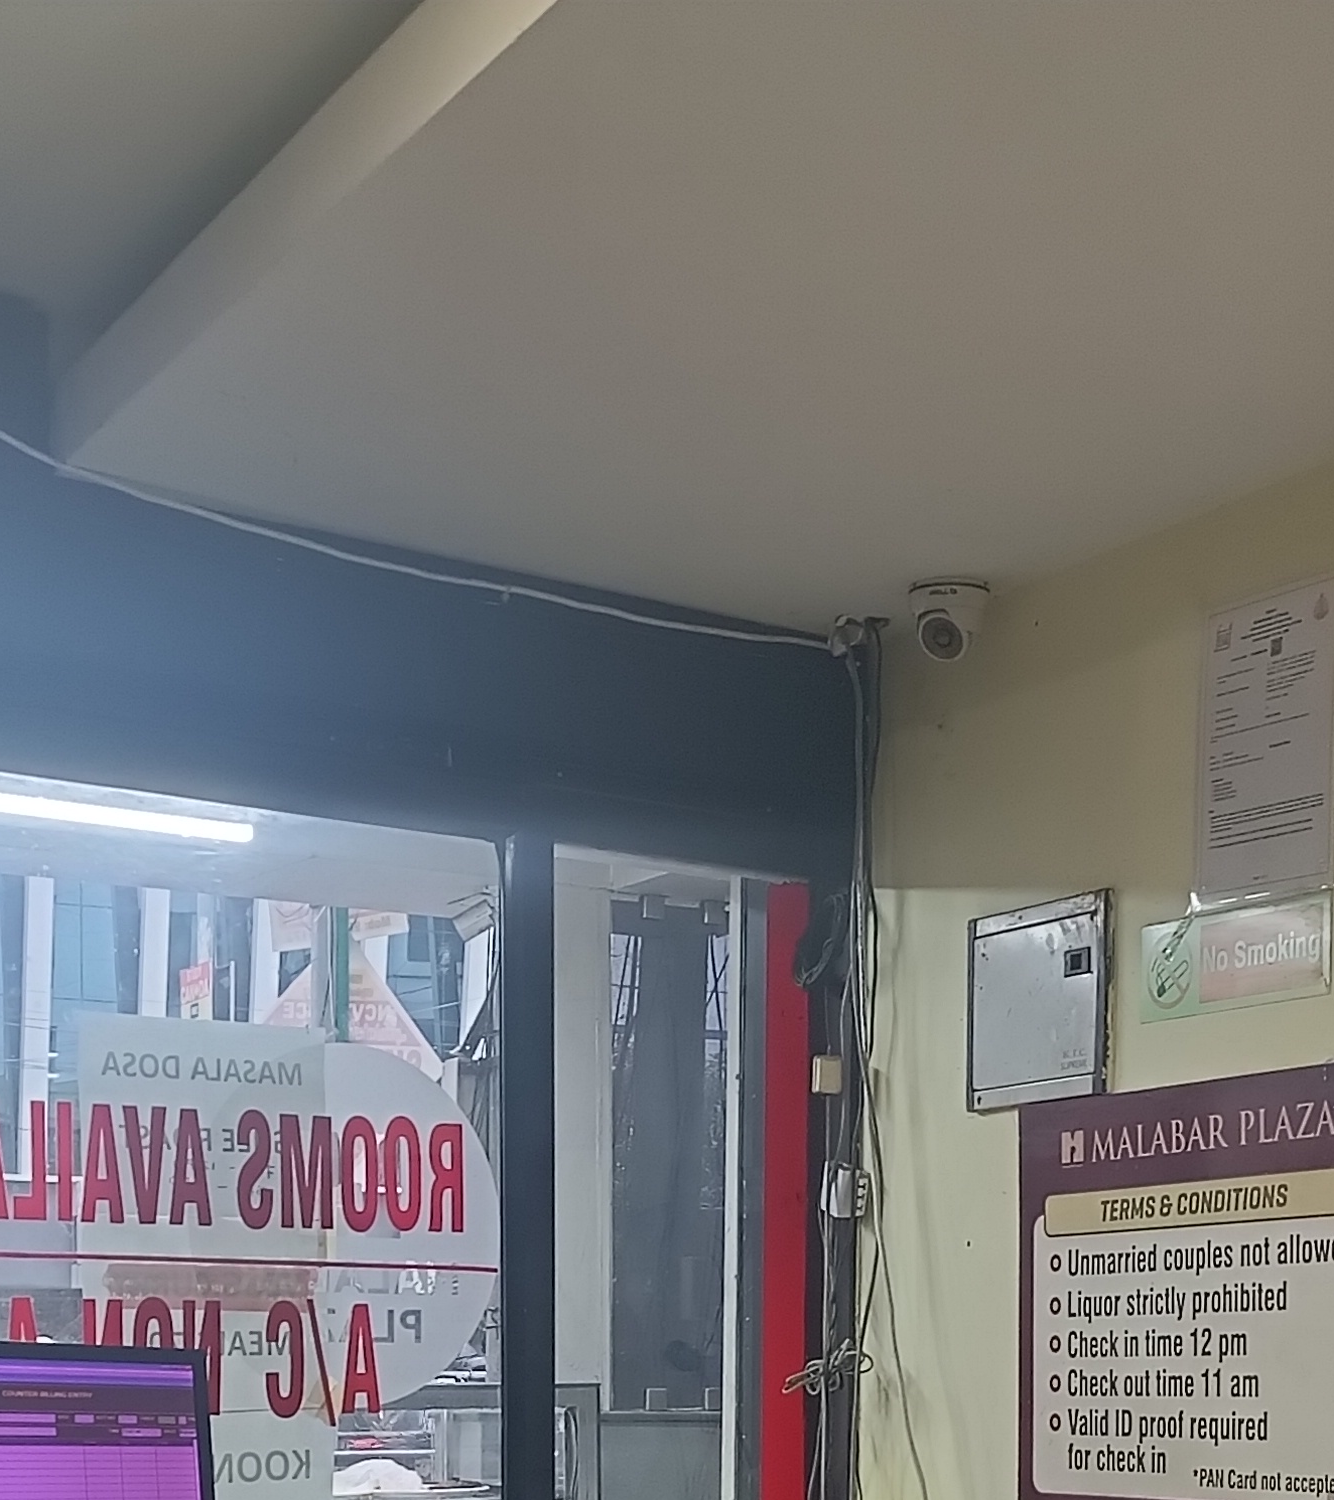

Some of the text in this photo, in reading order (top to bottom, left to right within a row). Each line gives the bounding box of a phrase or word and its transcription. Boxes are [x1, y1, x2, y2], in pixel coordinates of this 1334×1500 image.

[1202, 929, 1322, 975] No Smoking
[1091, 1112, 1229, 1163] MALABAR
[1100, 1184, 1289, 1224] TERMS & CONDITIONS
[1067, 1243, 1157, 1277] Unmarried
[1163, 1239, 1234, 1277] couples
[1240, 1236, 1271, 1267] not
[1067, 1280, 1288, 1324] Liquor strictly prohibited
[1067, 1327, 1248, 1363] Check in time 12 pm
[1067, 1368, 1260, 1398] Check out time 11 am
[1067, 1408, 1269, 1447] Valid ID proof required
[1067, 1444, 1167, 1475] for check in
[1227, 1468, 1258, 1491] Card
[1260, 1470, 1282, 1492] not
